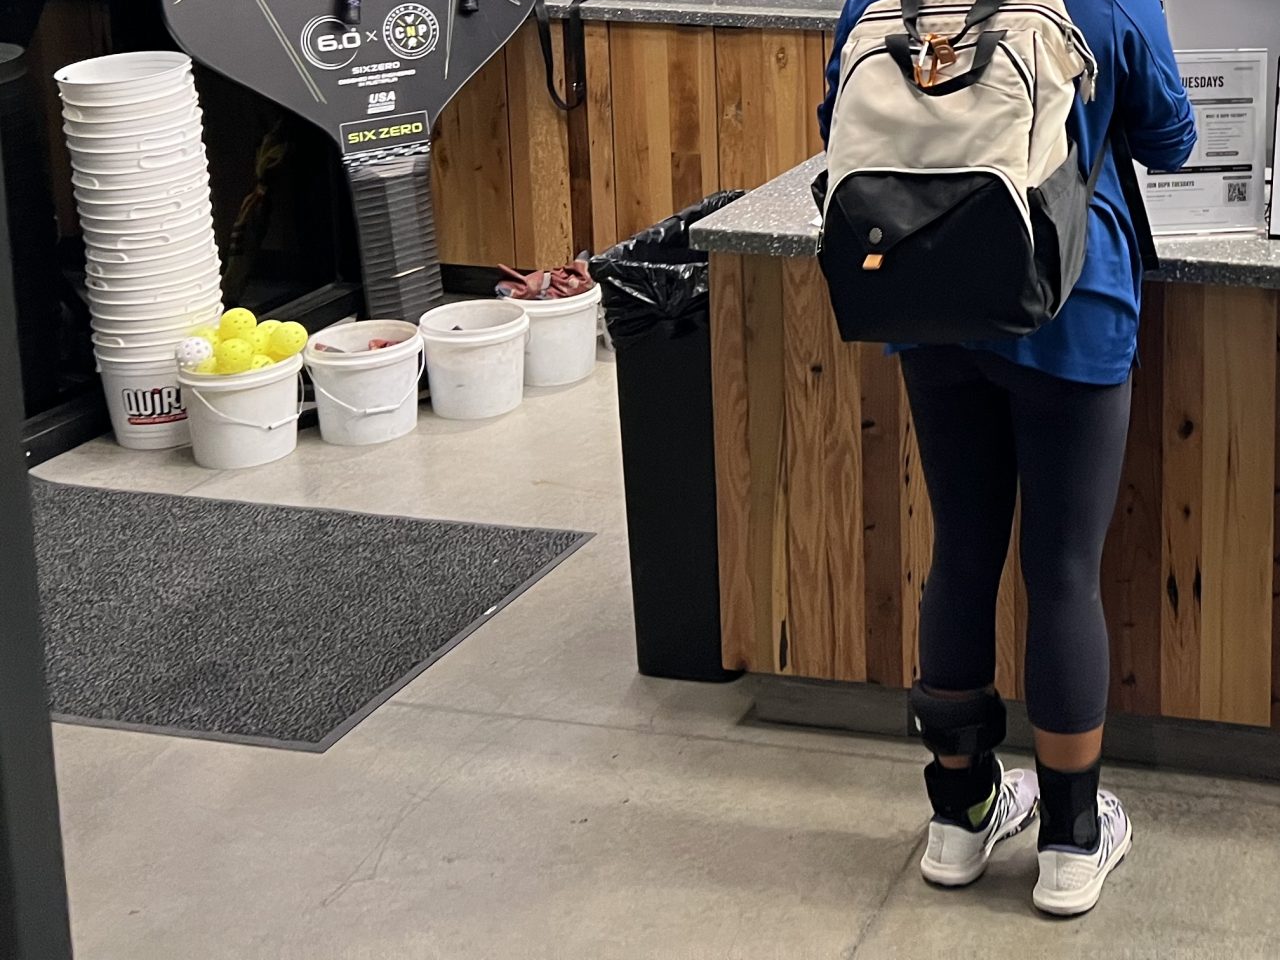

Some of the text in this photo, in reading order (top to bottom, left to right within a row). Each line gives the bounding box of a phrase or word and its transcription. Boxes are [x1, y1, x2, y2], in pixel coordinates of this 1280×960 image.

[317, 31, 361, 52] 6.0
[351, 61, 401, 75] SIXZERO
[1180, 76, 1225, 88] UESDAYS
[368, 90, 396, 104] USA
[347, 122, 424, 144] SIX ZERO
